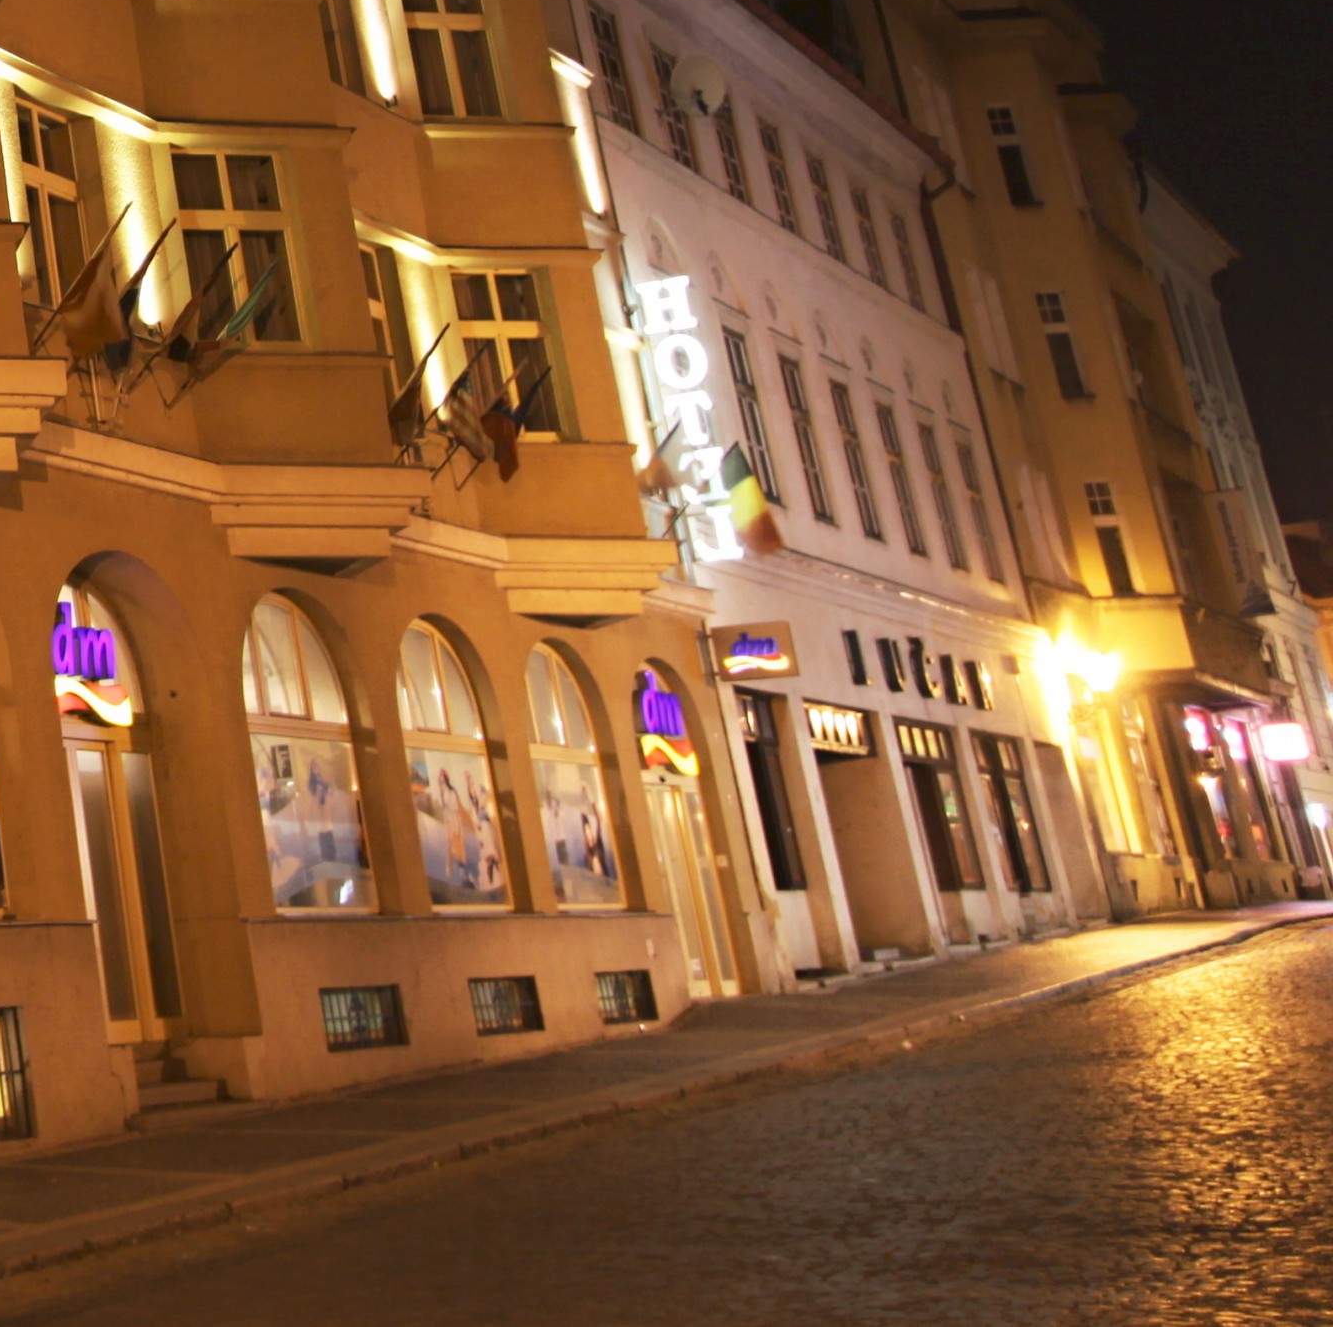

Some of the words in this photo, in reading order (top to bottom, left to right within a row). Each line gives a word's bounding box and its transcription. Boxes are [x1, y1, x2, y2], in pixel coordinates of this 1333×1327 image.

[52, 601, 116, 680] dm
[730, 631, 778, 657] dm
[640, 669, 687, 738] dm
